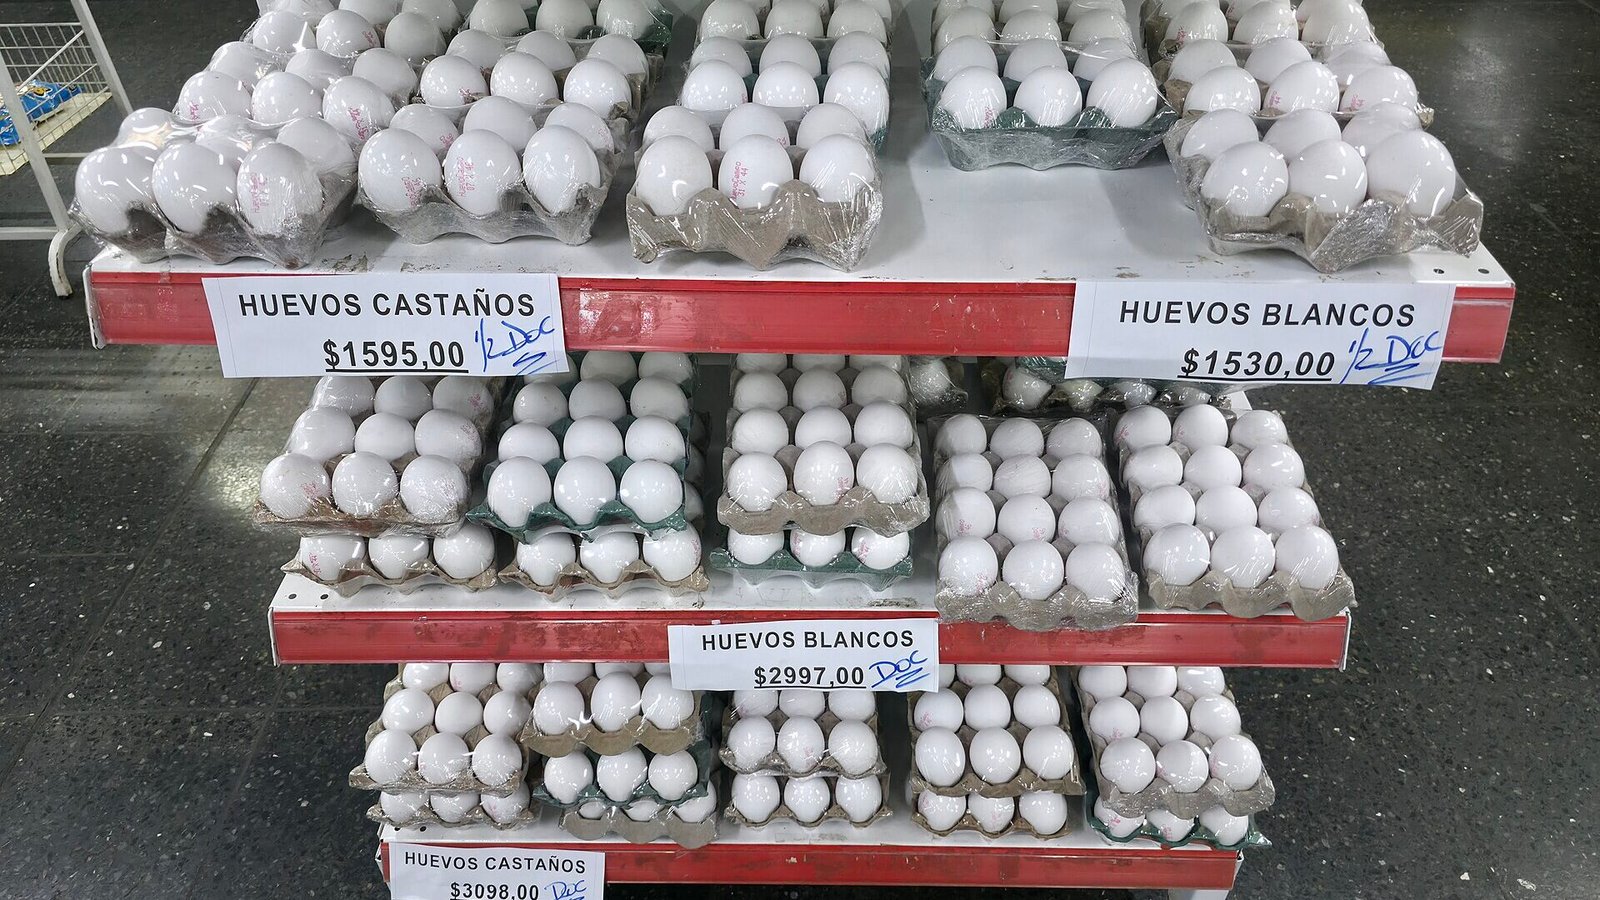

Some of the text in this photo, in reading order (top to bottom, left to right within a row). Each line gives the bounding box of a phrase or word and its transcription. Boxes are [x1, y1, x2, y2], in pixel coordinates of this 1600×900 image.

[239, 288, 535, 317] HUEVOS CASTAÑOS
[1119, 300, 1415, 328] HUEVOS BLANCOS
[323, 338, 465, 370] $1595,00
[1180, 348, 1335, 379] $1530,00
[702, 630, 914, 650] HUEVOS BLANCOS
[754, 666, 864, 688] $2997,00
[405, 851, 586, 874] HUEVOS CASTAÑOS
[450, 881, 539, 900] $3098,00
